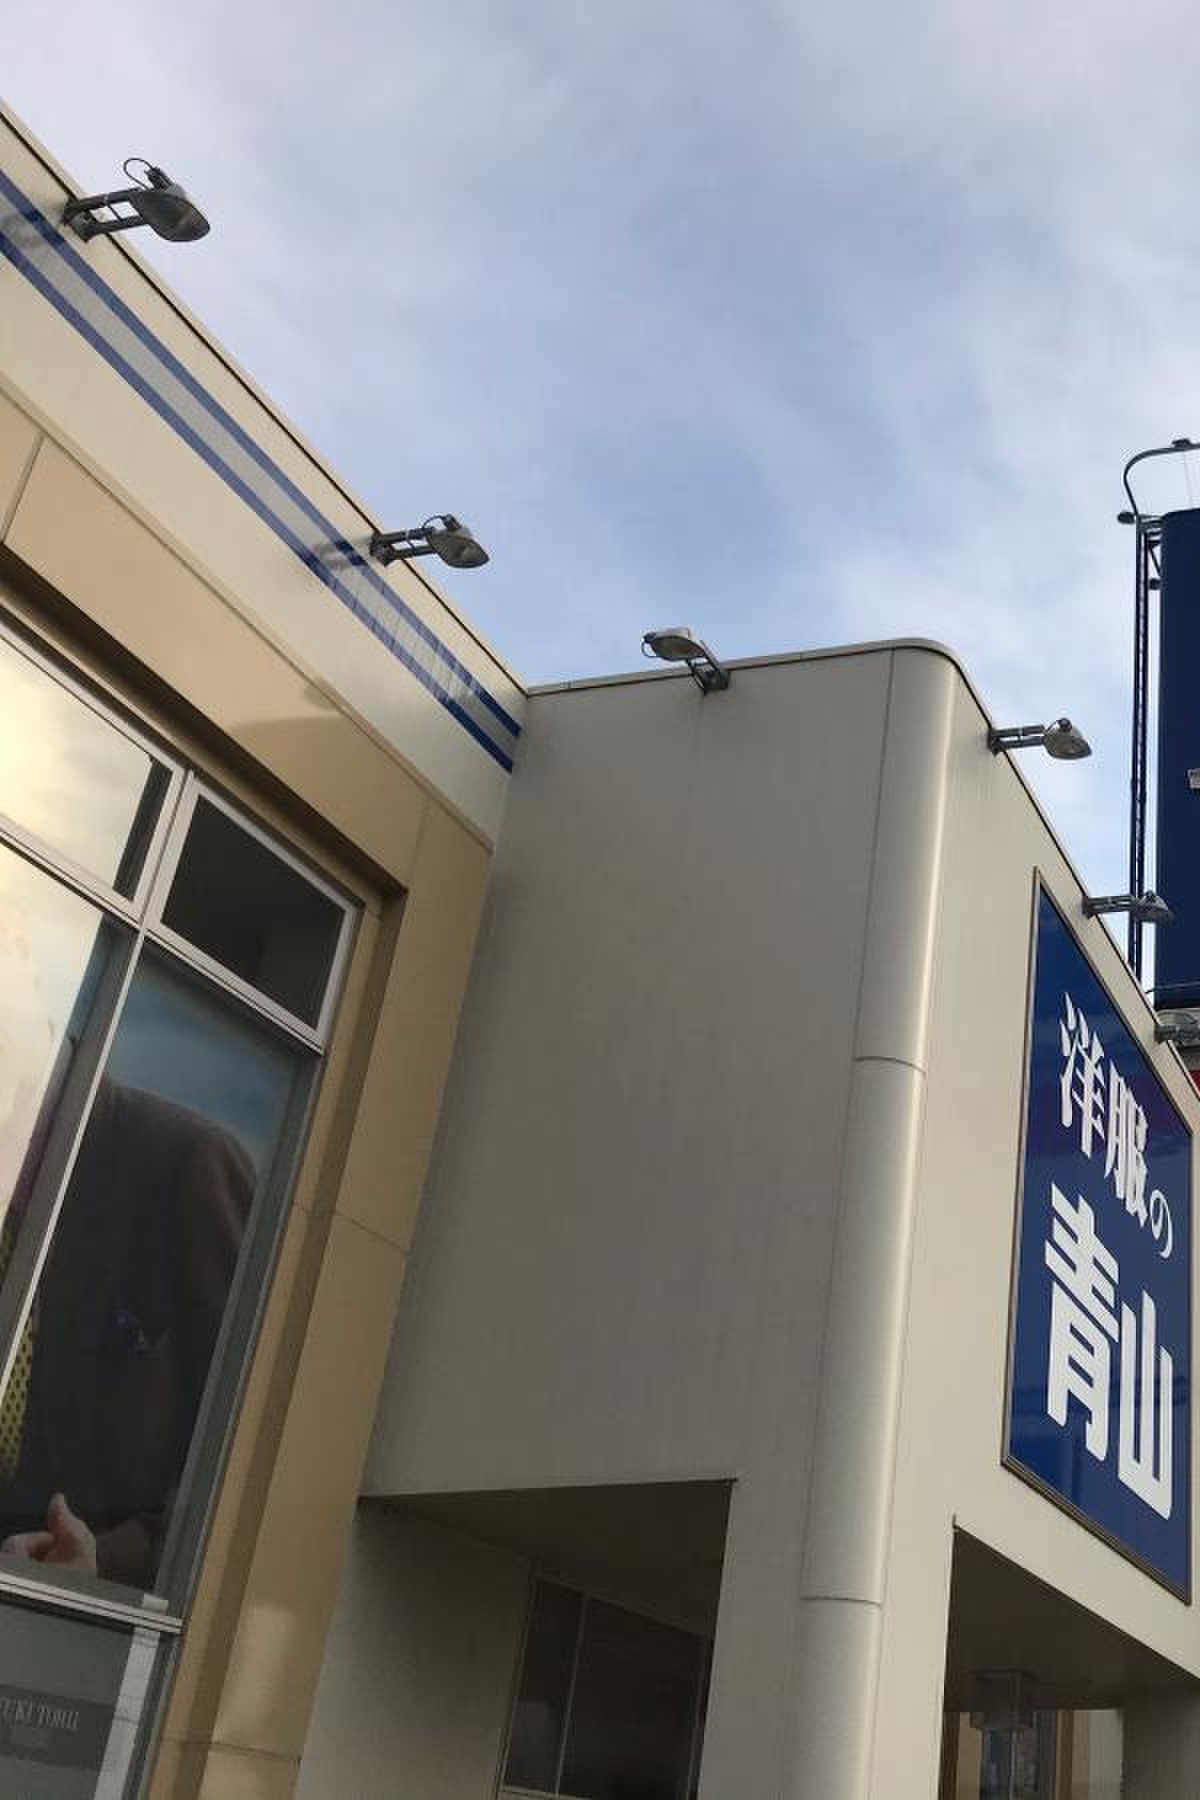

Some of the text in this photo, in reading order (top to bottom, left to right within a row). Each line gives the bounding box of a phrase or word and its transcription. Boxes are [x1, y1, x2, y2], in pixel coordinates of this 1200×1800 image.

[1058, 991, 1174, 1259] 洋服の
[1044, 1180, 1174, 1521] 青山
